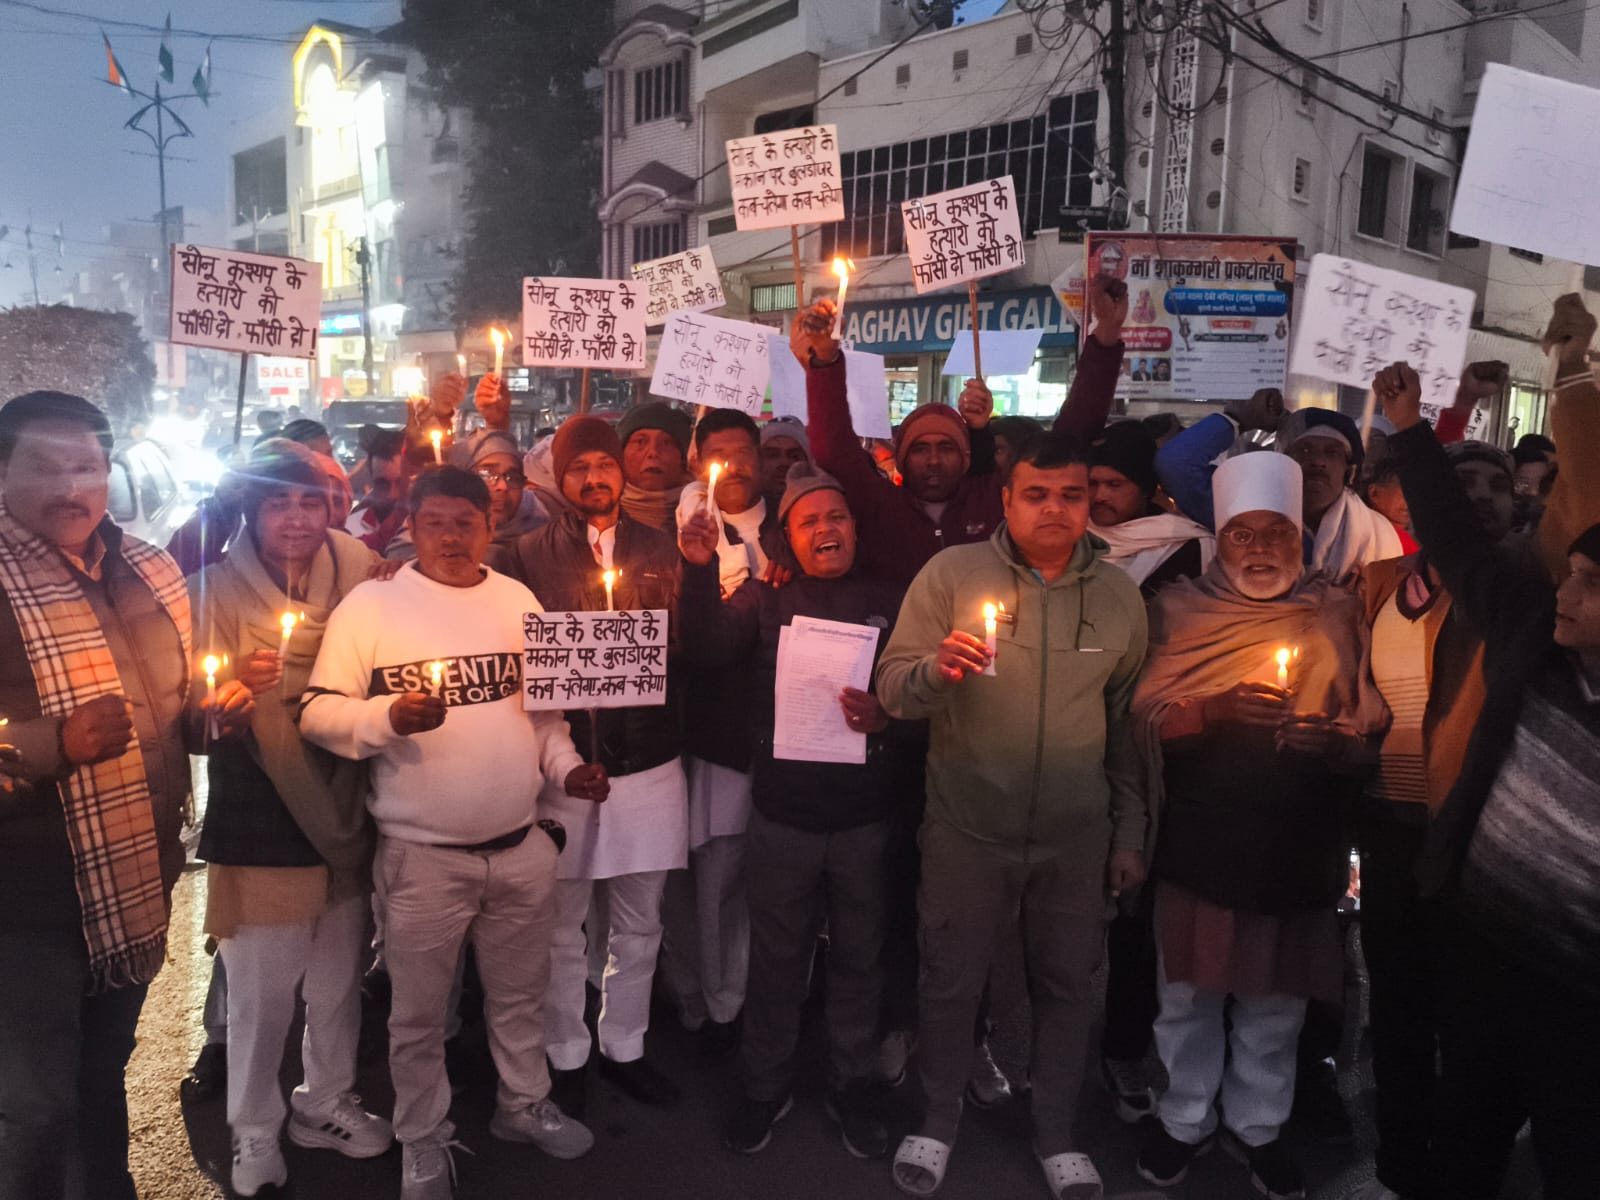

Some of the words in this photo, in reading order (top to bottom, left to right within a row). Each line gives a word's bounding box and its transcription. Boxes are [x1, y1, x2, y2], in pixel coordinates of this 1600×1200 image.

[762, 136, 777, 160] के
[820, 128, 834, 151] के
[768, 166, 785, 186] पर
[792, 190, 812, 210] कब
[904, 200, 945, 230] सोनू
[990, 180, 1008, 210] के
[976, 212, 998, 242] को
[178, 244, 220, 283] सोनू
[285, 262, 307, 289] के
[686, 252, 702, 270] के
[949, 250, 965, 276] दो
[258, 286, 284, 316] को
[526, 278, 560, 308] सोनू
[619, 283, 636, 309] के
[597, 308, 617, 334] को
[846, 307, 931, 344] AGHAV
[936, 302, 994, 340] GIFT
[260, 367, 305, 378] SALE
[524, 613, 564, 646] सोनू
[566, 613, 584, 643] के
[641, 611, 660, 641] के
[382, 654, 524, 692] ESSENTIA
[524, 648, 574, 668] मकान
[576, 648, 599, 668] पर
[467, 686, 494, 702] OF
[526, 677, 559, 700] कब
[601, 675, 628, 696] कब
[626, 666, 666, 696] चलेगा
